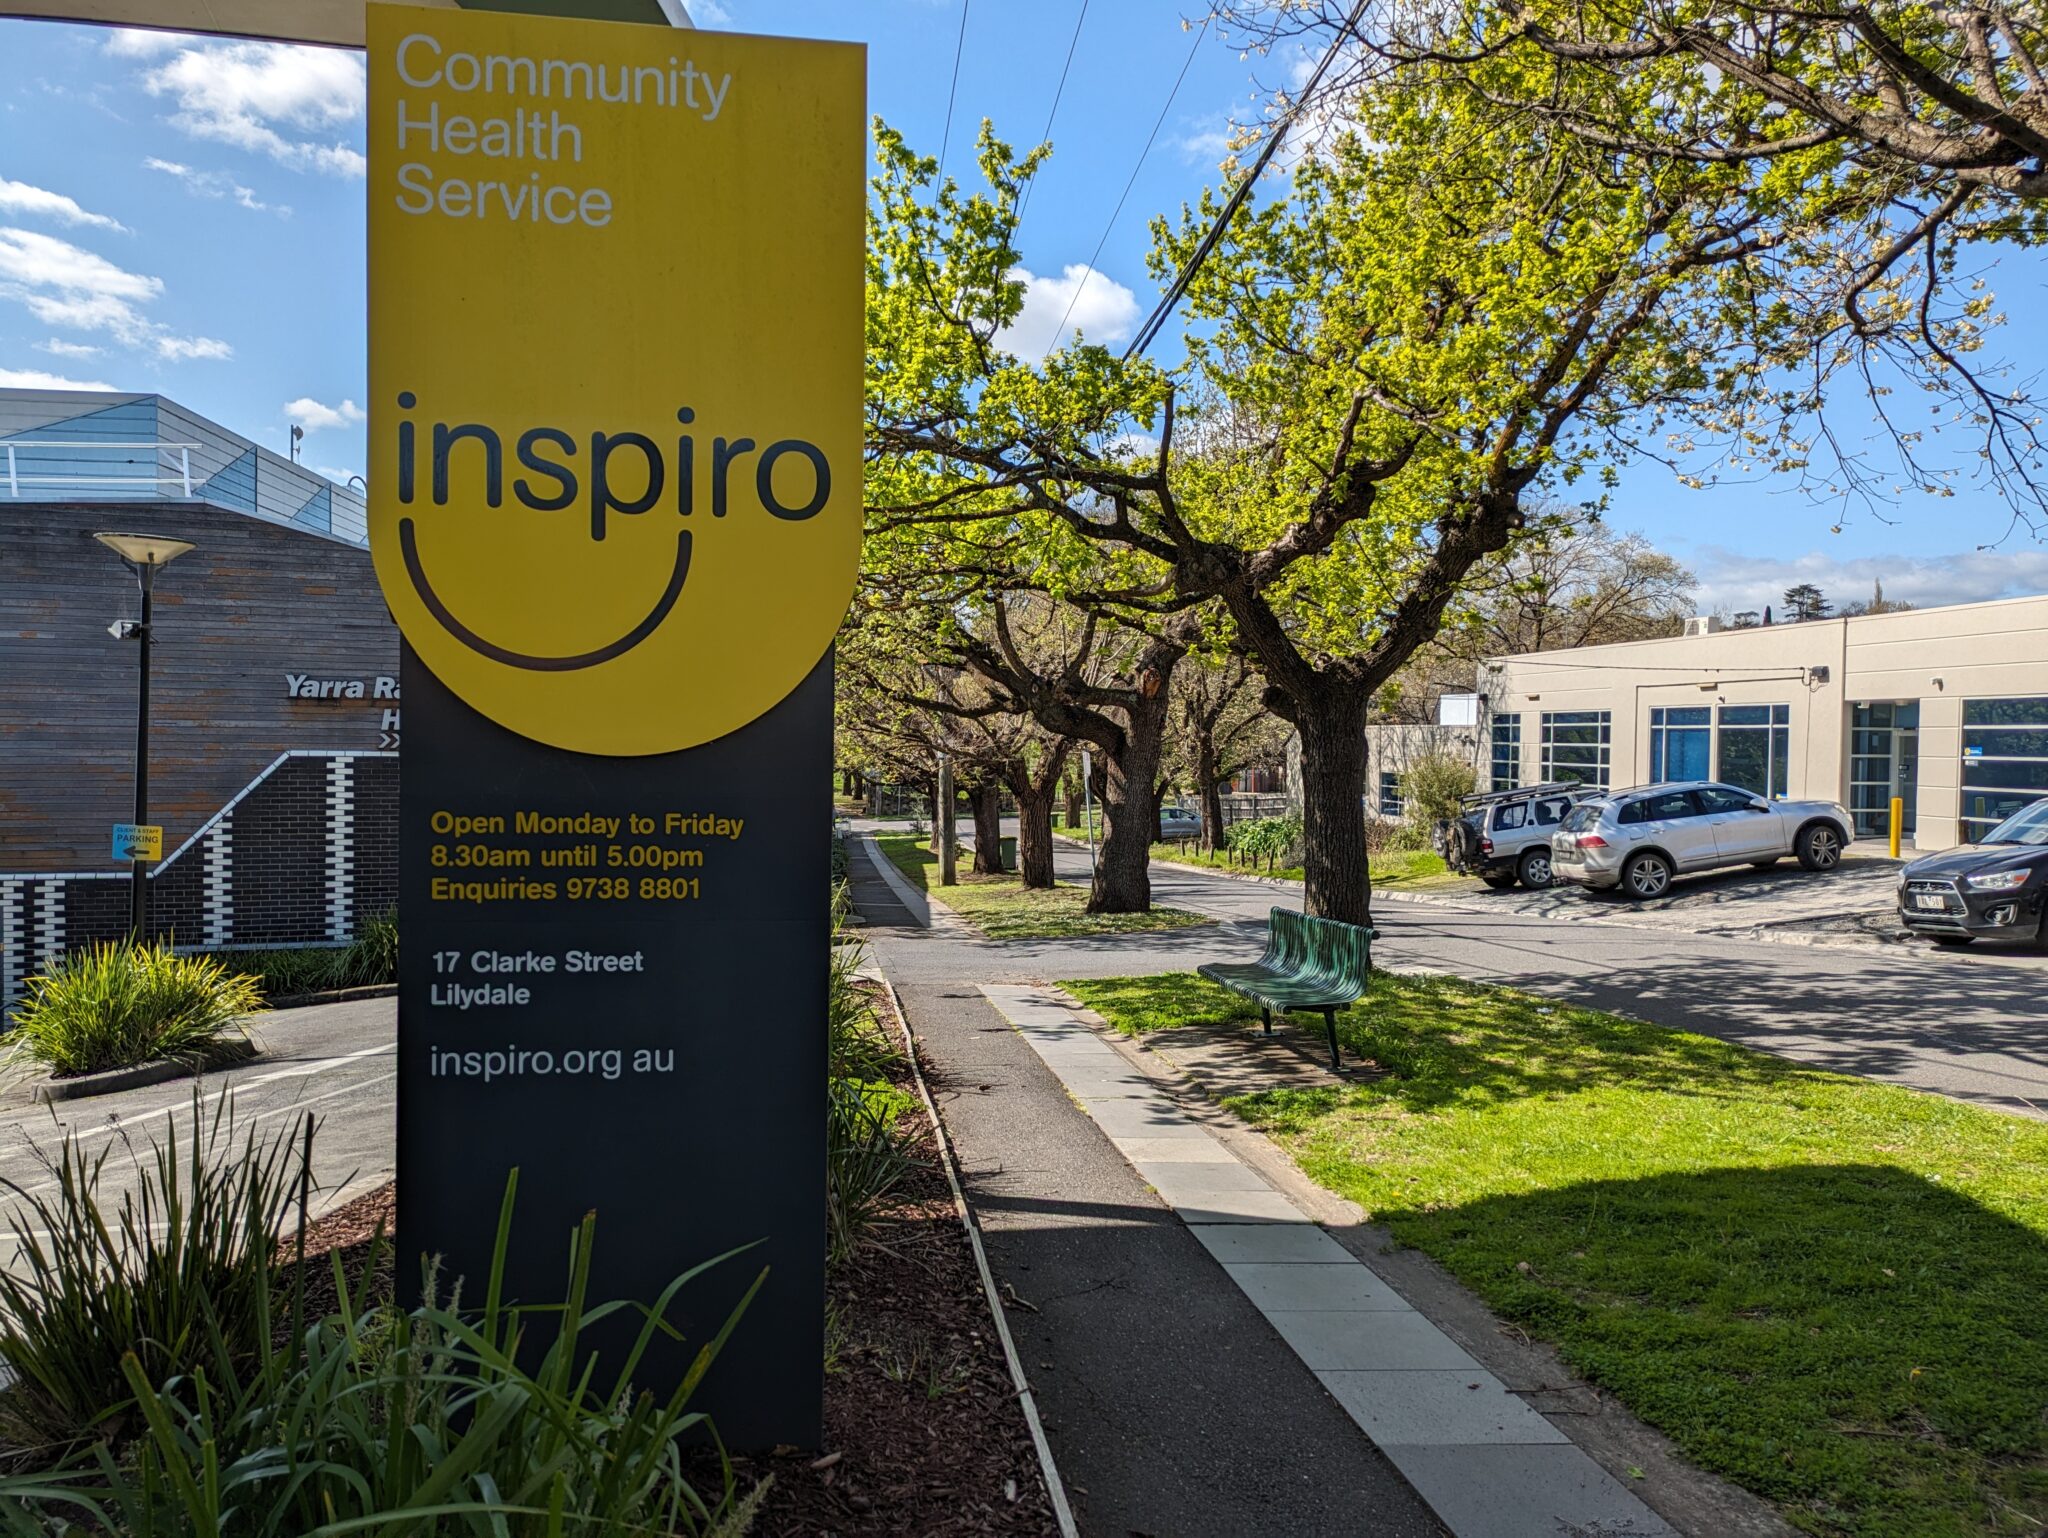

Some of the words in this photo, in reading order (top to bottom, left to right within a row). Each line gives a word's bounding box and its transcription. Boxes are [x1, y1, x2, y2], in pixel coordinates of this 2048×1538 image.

[396, 33, 731, 121] Community
[397, 100, 582, 162] Health
[396, 162, 612, 227] Service
[397, 391, 831, 541] inspiro
[285, 674, 365, 699] Yarra
[117, 834, 159, 844] PARKING
[431, 811, 504, 838] Open
[515, 811, 621, 839] Monday
[628, 813, 655, 835] to
[665, 813, 744, 840] Friday
[431, 844, 530, 867] 8.30am
[541, 844, 597, 867] until
[607, 845, 703, 871] 5.00pm
[431, 876, 557, 904] Enquiries
[566, 877, 630, 899] 9738
[639, 877, 700, 900] 8801
[432, 951, 461, 973] 17
[470, 950, 557, 973] Clarke
[564, 950, 644, 973] Street
[431, 982, 531, 1010] Lilydale
[431, 1044, 622, 1082] inspiro.org
[632, 1049, 674, 1072] au
